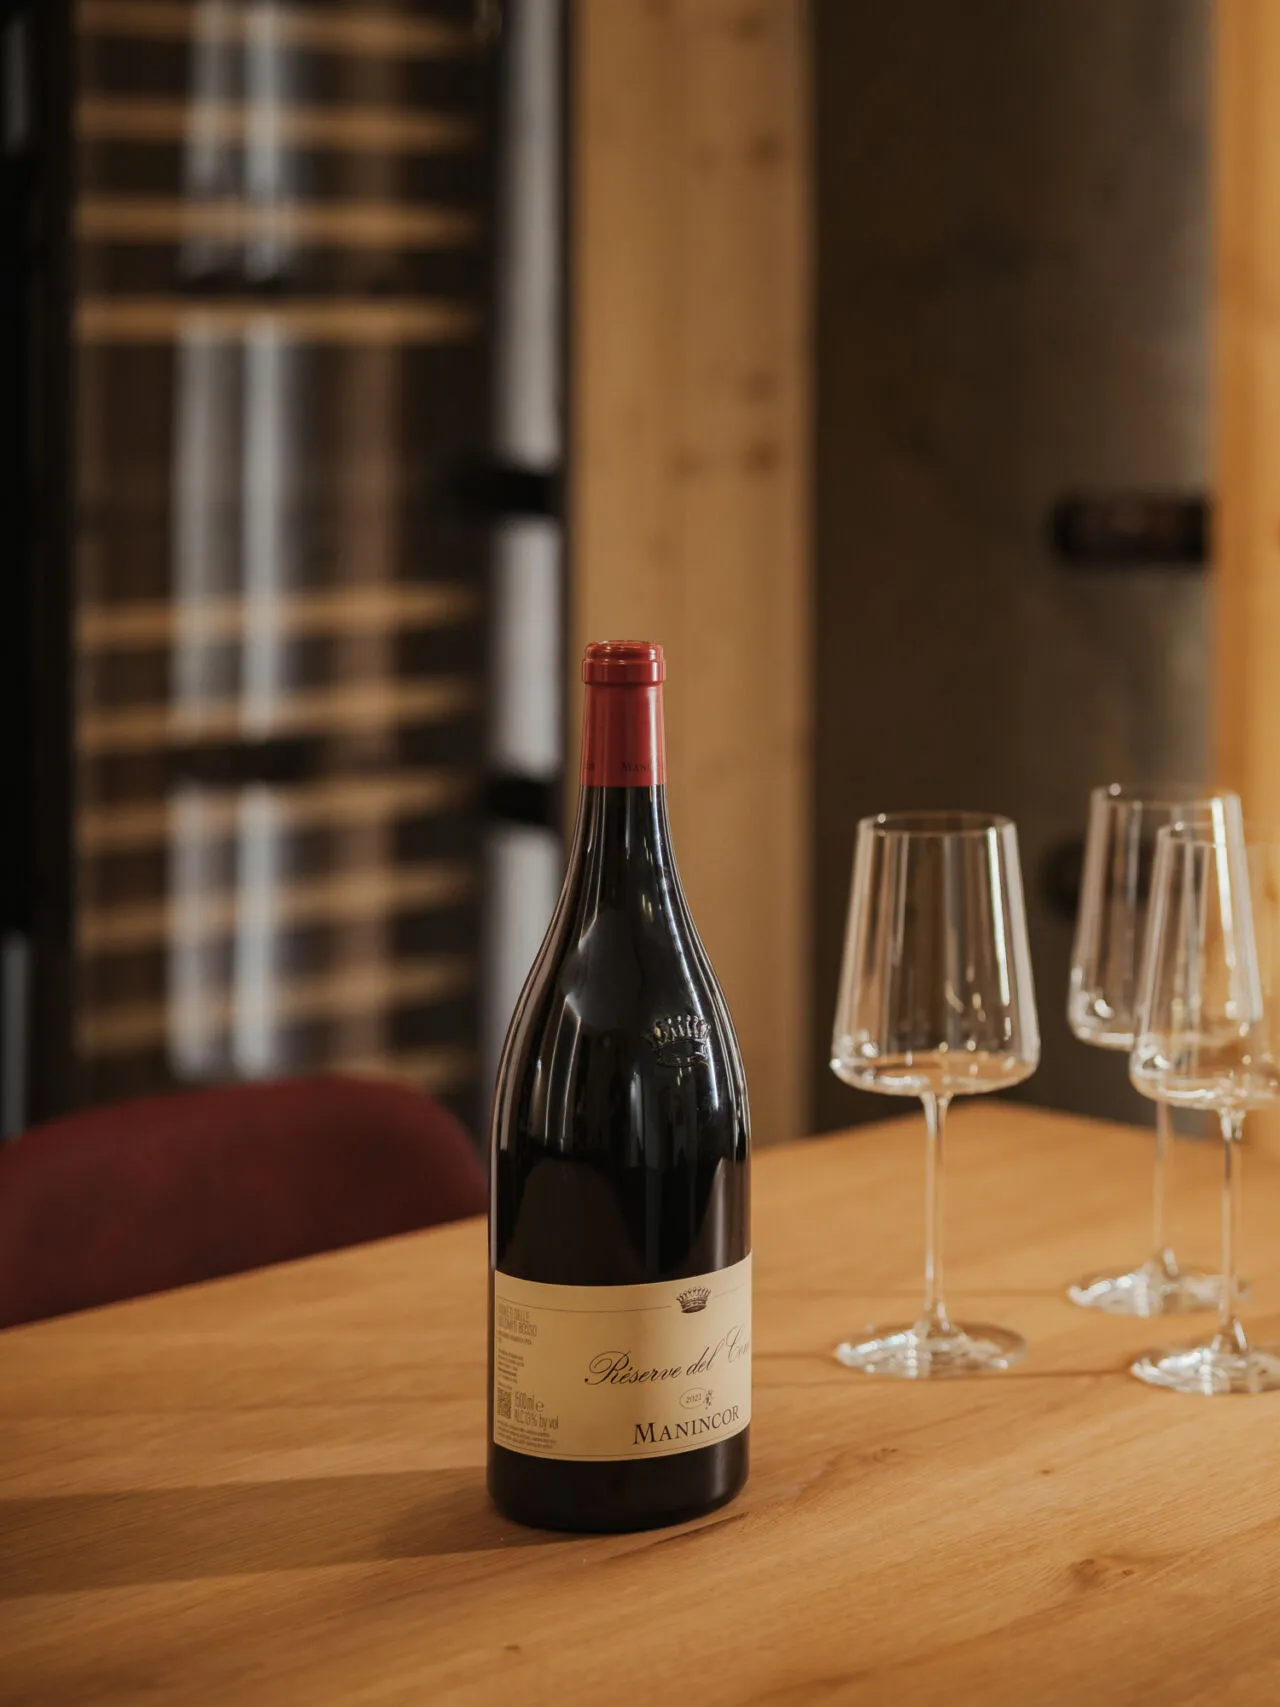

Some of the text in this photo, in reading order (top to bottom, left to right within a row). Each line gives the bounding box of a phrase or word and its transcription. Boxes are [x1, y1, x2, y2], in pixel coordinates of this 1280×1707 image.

[584, 1350, 682, 1385] Réserve
[685, 1338, 725, 1376] del
[632, 1405, 740, 1445] MANINCOR
